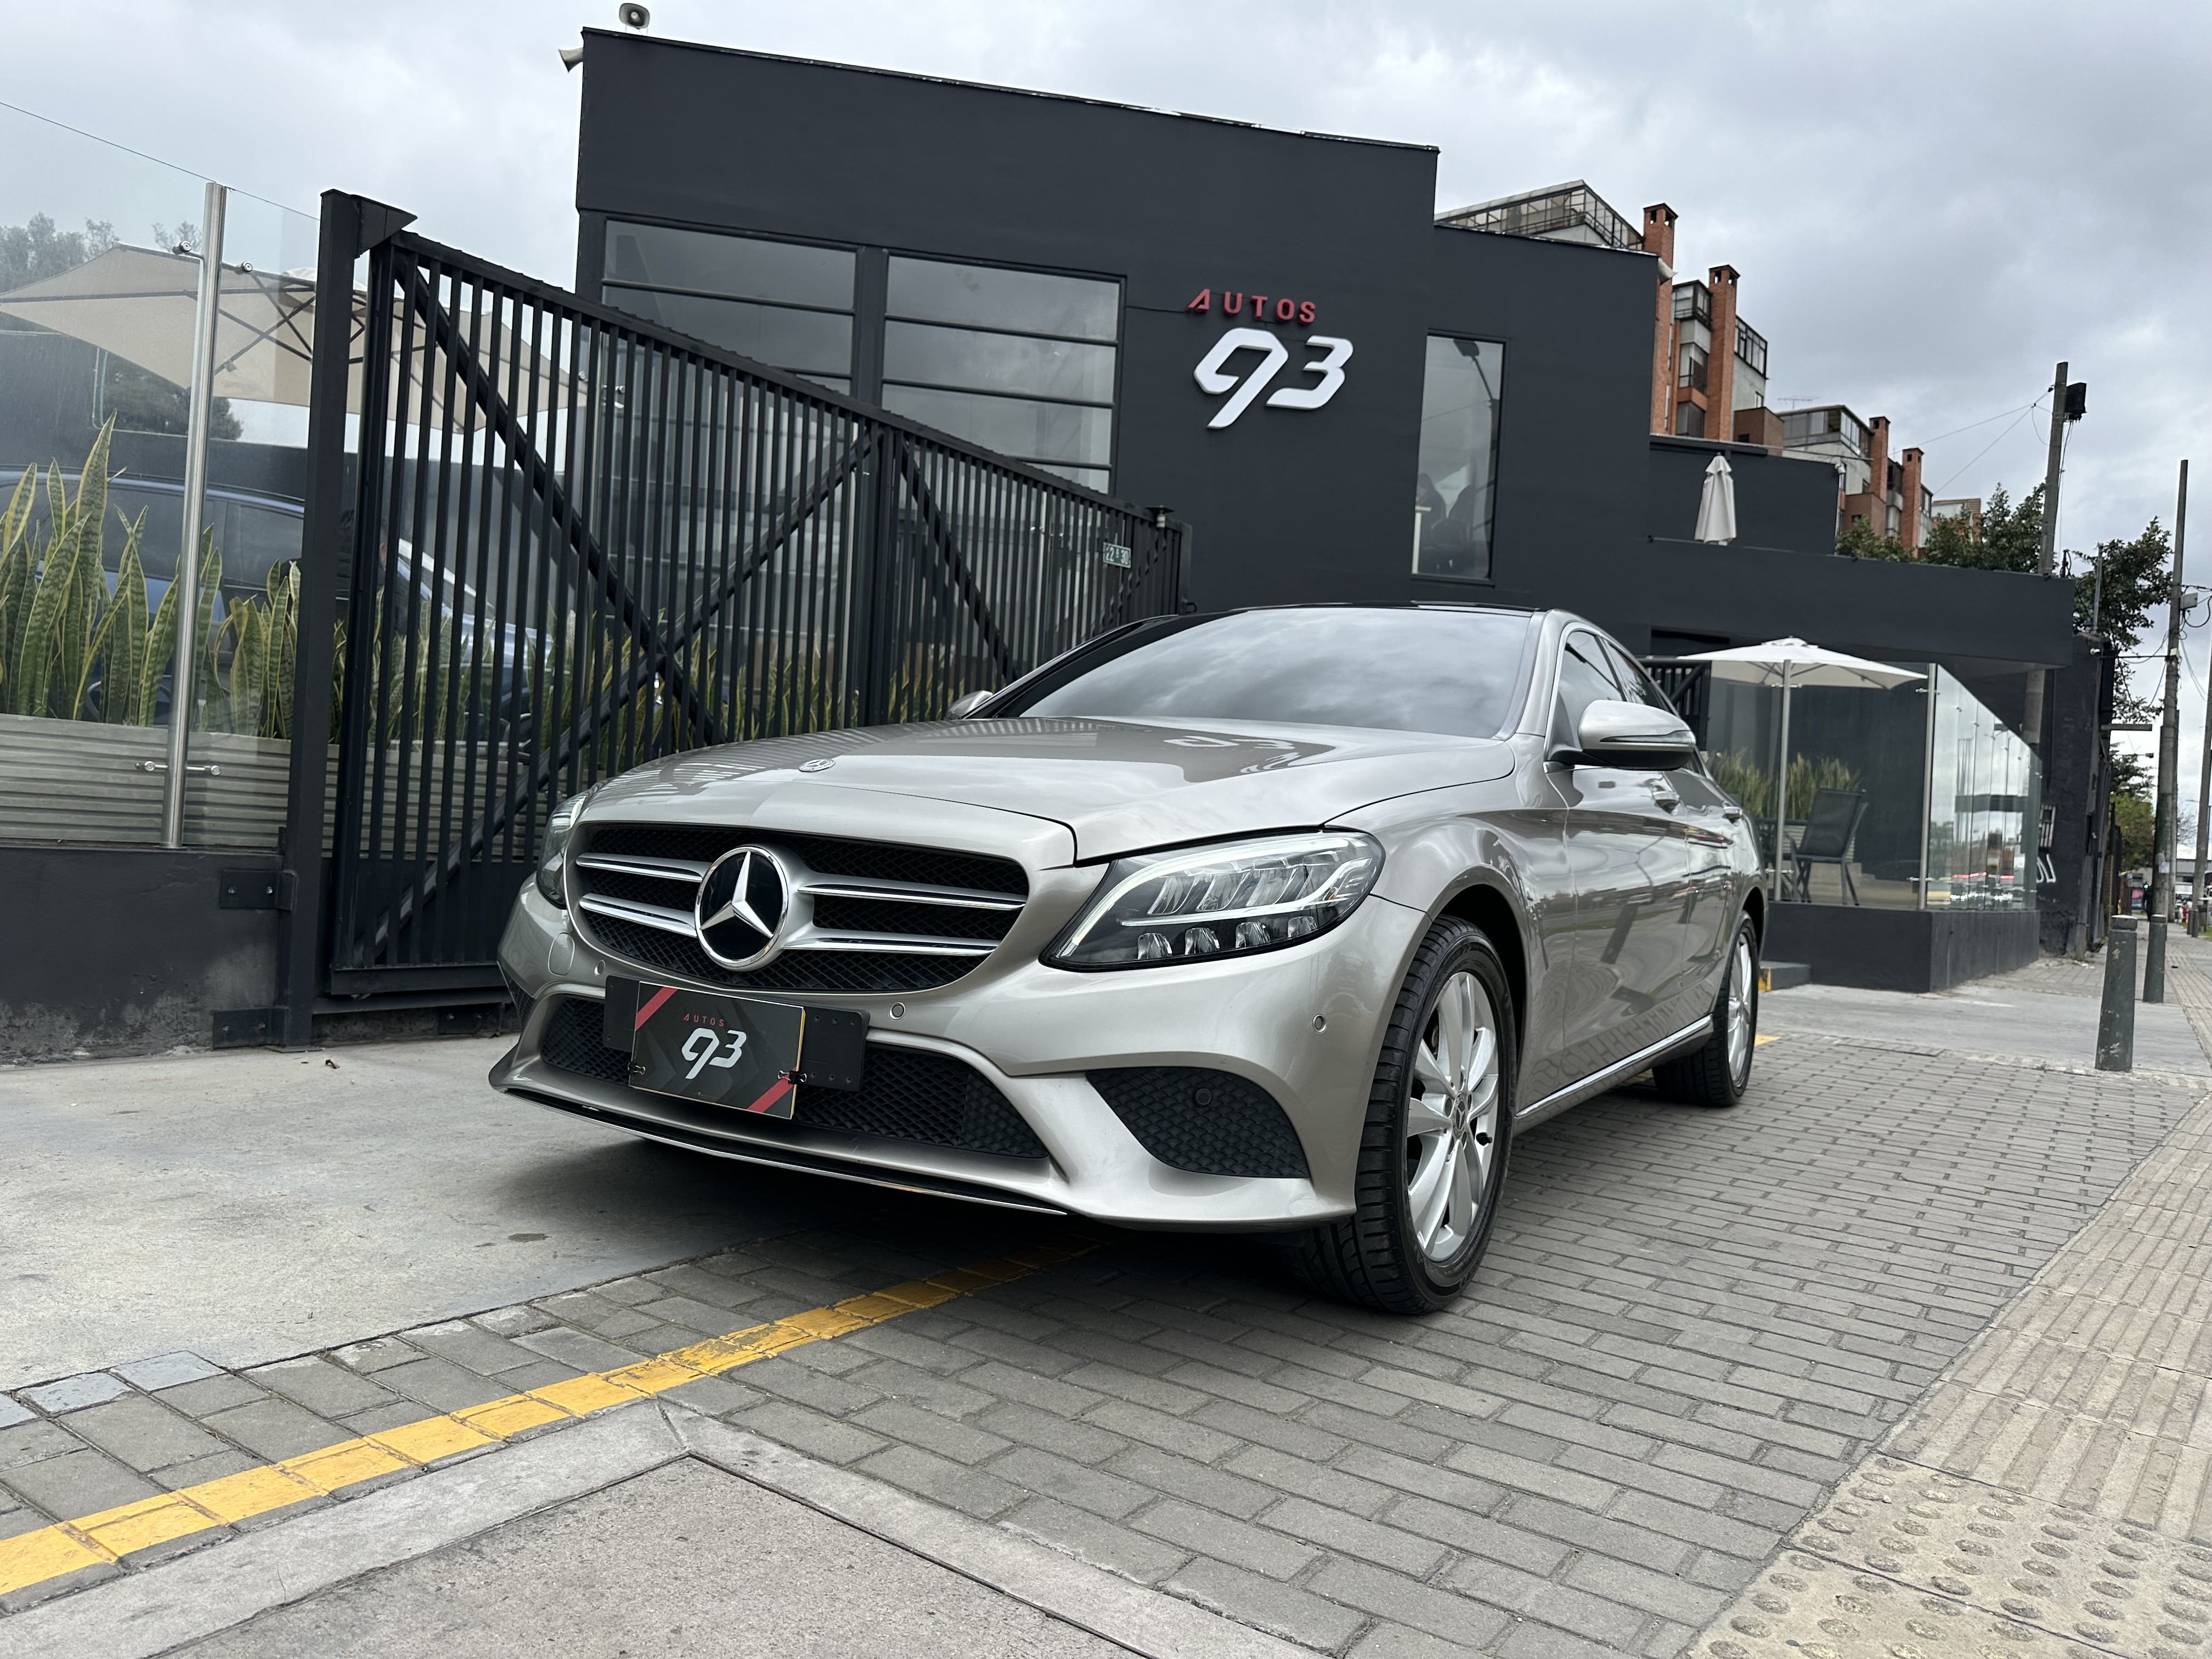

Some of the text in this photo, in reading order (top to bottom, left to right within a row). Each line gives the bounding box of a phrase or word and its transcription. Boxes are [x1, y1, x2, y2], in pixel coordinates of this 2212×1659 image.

[1187, 289, 1316, 325] AUTOS
[1193, 327, 1354, 429] 93
[684, 1014, 724, 1026] AUTOS
[681, 1028, 747, 1080] 93
